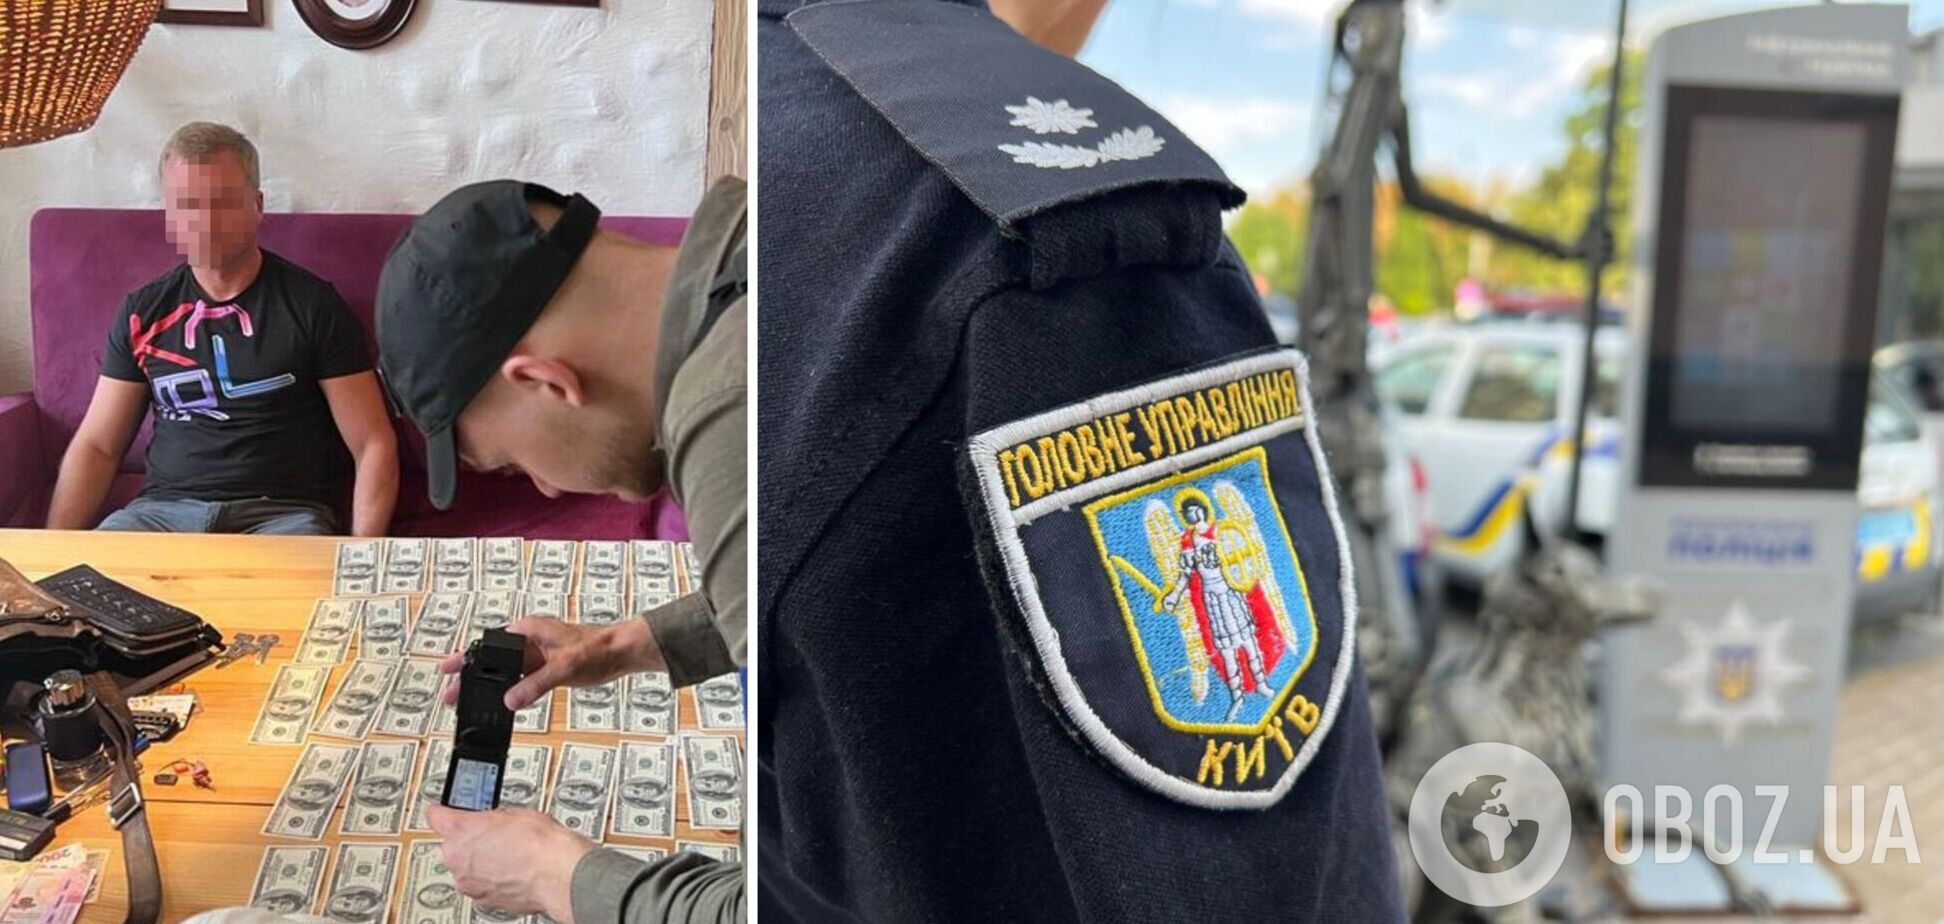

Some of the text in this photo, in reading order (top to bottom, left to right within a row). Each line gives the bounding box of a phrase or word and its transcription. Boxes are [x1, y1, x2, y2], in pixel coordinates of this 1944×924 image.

[999, 369, 1300, 506] ГОЛОВНЕ УПРАВЛІННЯ
[1198, 694, 1320, 785] КИЇВ
